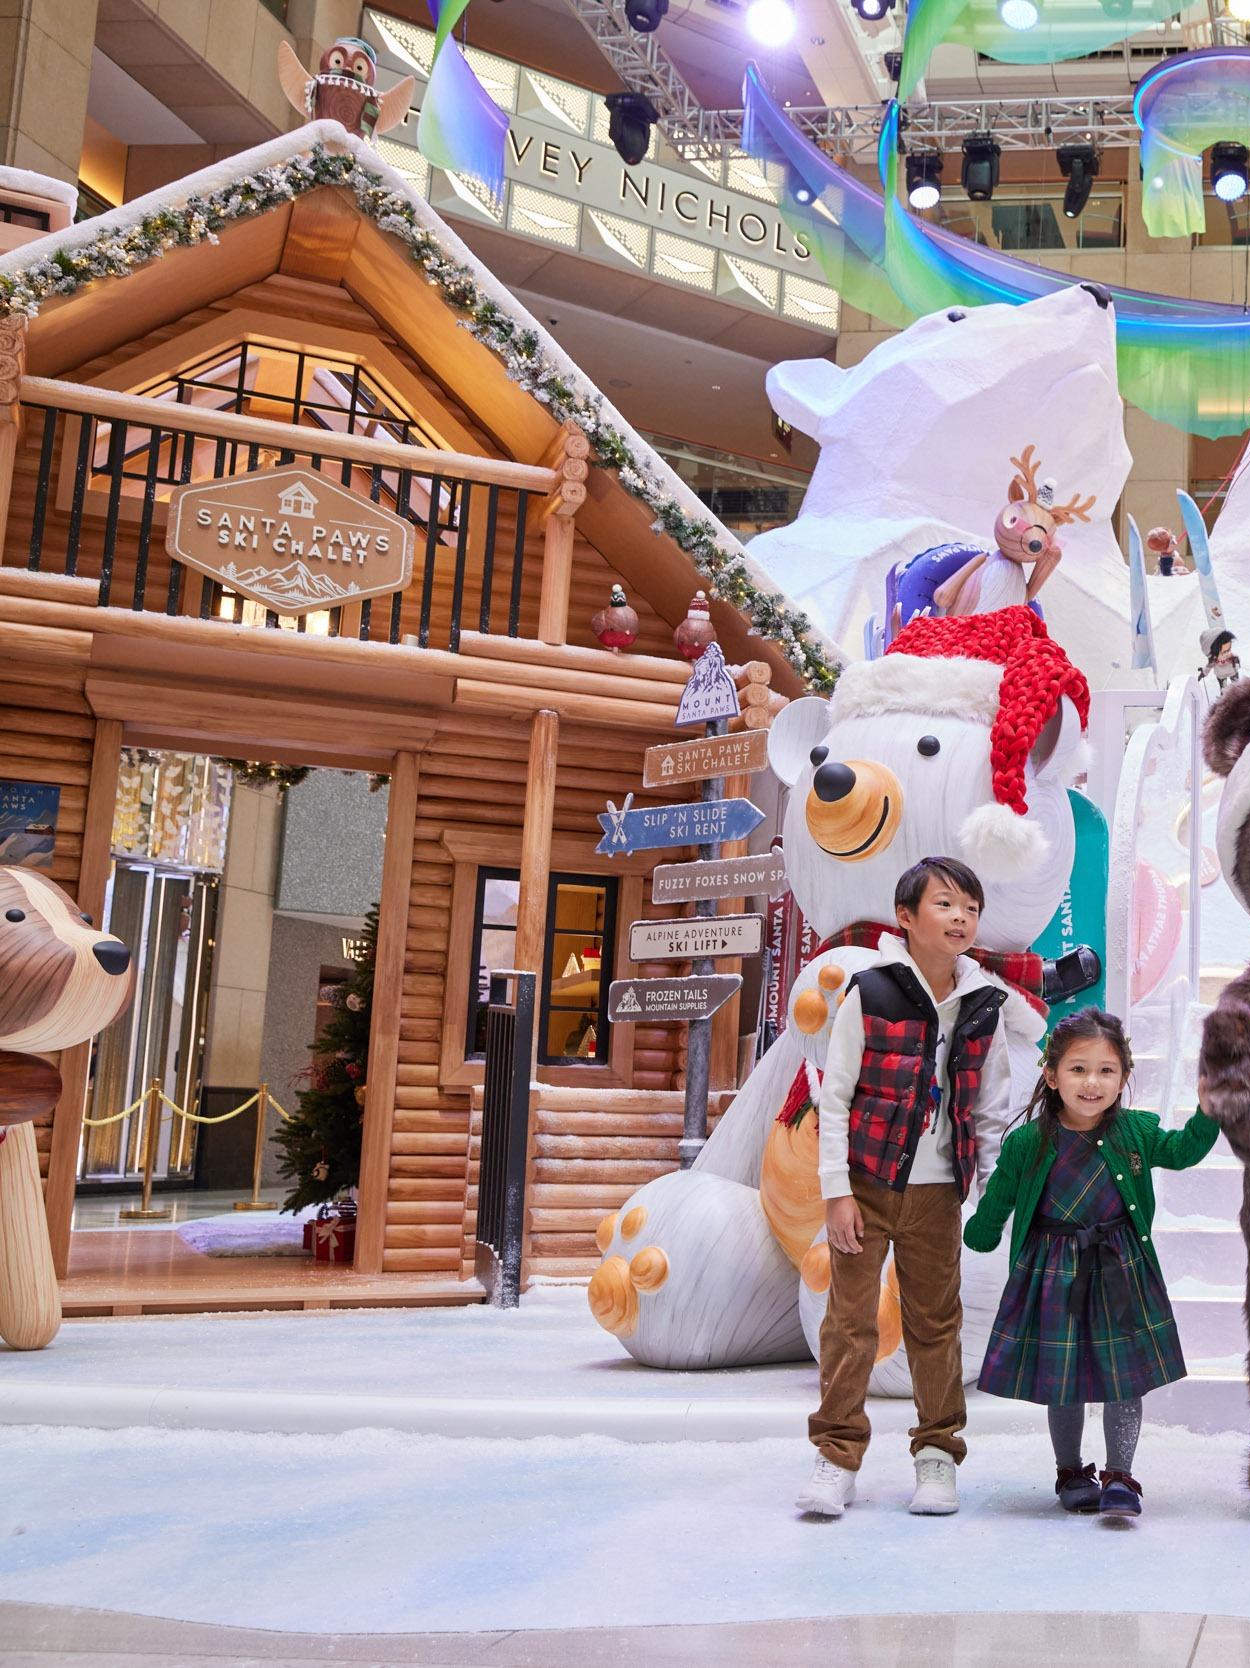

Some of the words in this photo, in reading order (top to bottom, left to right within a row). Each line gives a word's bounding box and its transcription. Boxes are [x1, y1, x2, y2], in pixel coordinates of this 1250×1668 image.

[619, 168, 811, 261] NICHOLS
[197, 508, 293, 537] SANTA
[312, 526, 390, 552] PAWS
[218, 530, 258, 549] SKI
[273, 538, 368, 564] CHALET
[682, 694, 730, 710] MOUNT
[682, 710, 706, 720] SANTA
[710, 705, 730, 714] PAWS
[677, 748, 712, 762] SANTA
[719, 742, 750, 755] PAWS
[676, 763, 696, 774] SKI
[703, 754, 749, 769] CHALET
[3, 795, 35, 803] ANTA
[644, 815, 668, 827] SLIP
[693, 807, 727, 821] SLIDE
[669, 827, 688, 838] SKI
[695, 822, 726, 835] RENT
[658, 878, 691, 890] FUZZY
[695, 875, 729, 888] FOXES
[734, 871, 765, 884] SNOW
[647, 929, 679, 941] ALPINE
[684, 926, 743, 938] ADVENTURE
[772, 907, 784, 957] SANTA
[668, 941, 688, 953] SKI
[694, 939, 718, 951] LIFT
[645, 990, 681, 1002] FROZEN
[684, 988, 708, 999] TAILS
[768, 961, 781, 1020] MOUNT
[645, 1003, 678, 1012] MOUNTAIN
[679, 1001, 707, 1010] SUPPLIES
